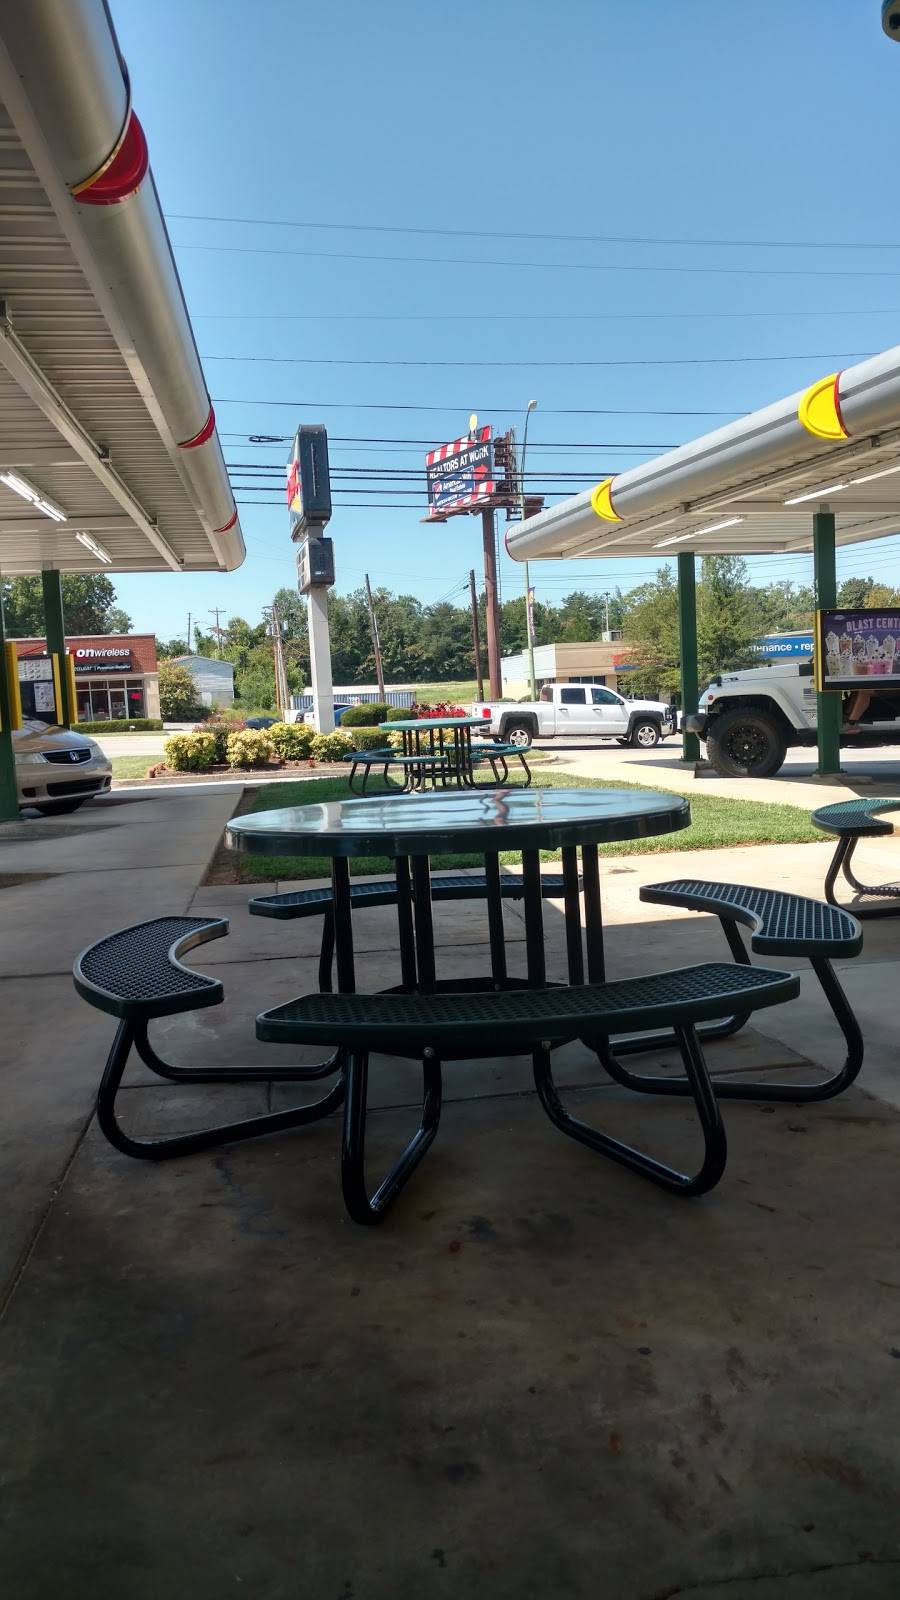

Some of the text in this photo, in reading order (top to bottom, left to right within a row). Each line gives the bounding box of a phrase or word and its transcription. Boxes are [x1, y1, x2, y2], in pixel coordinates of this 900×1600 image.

[460, 453, 468, 467] AT
[469, 445, 489, 463] WORK
[846, 617, 900, 631] BLAST CENT
